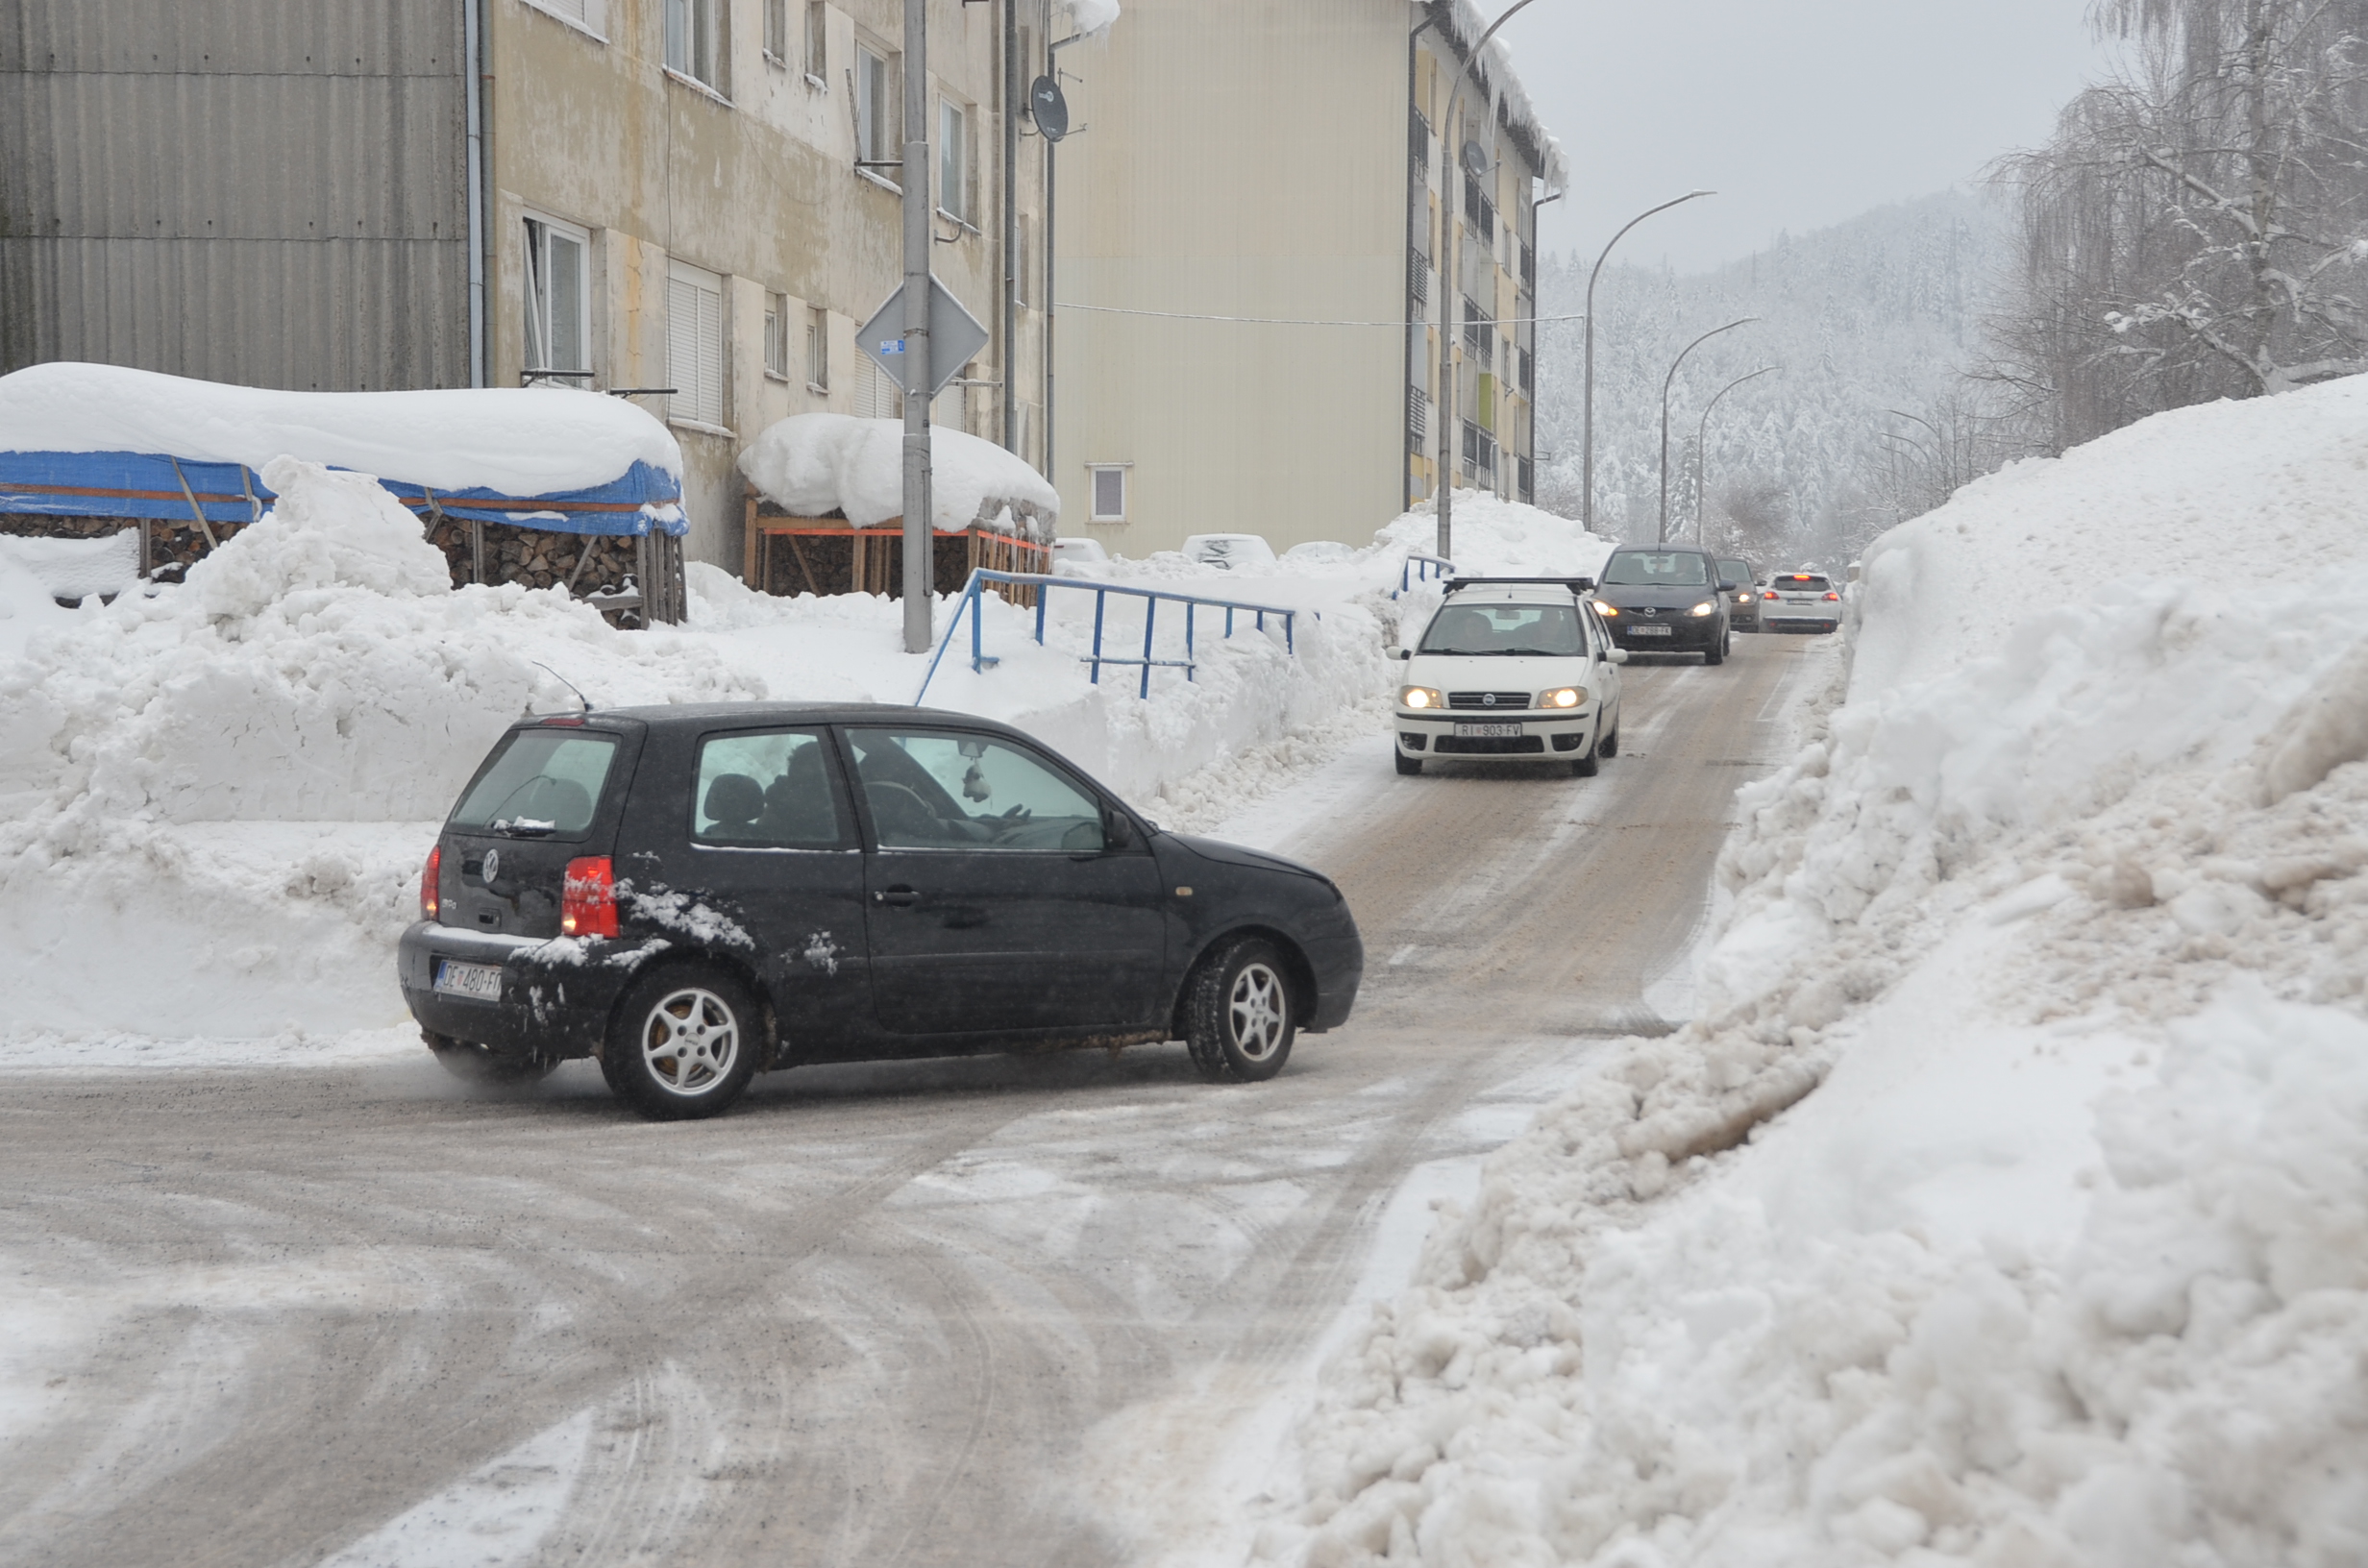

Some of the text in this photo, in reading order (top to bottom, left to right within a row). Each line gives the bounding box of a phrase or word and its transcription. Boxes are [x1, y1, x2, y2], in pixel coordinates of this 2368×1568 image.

[1462, 724, 1519, 736] RI 903-FV
[444, 965, 458, 988] DE
